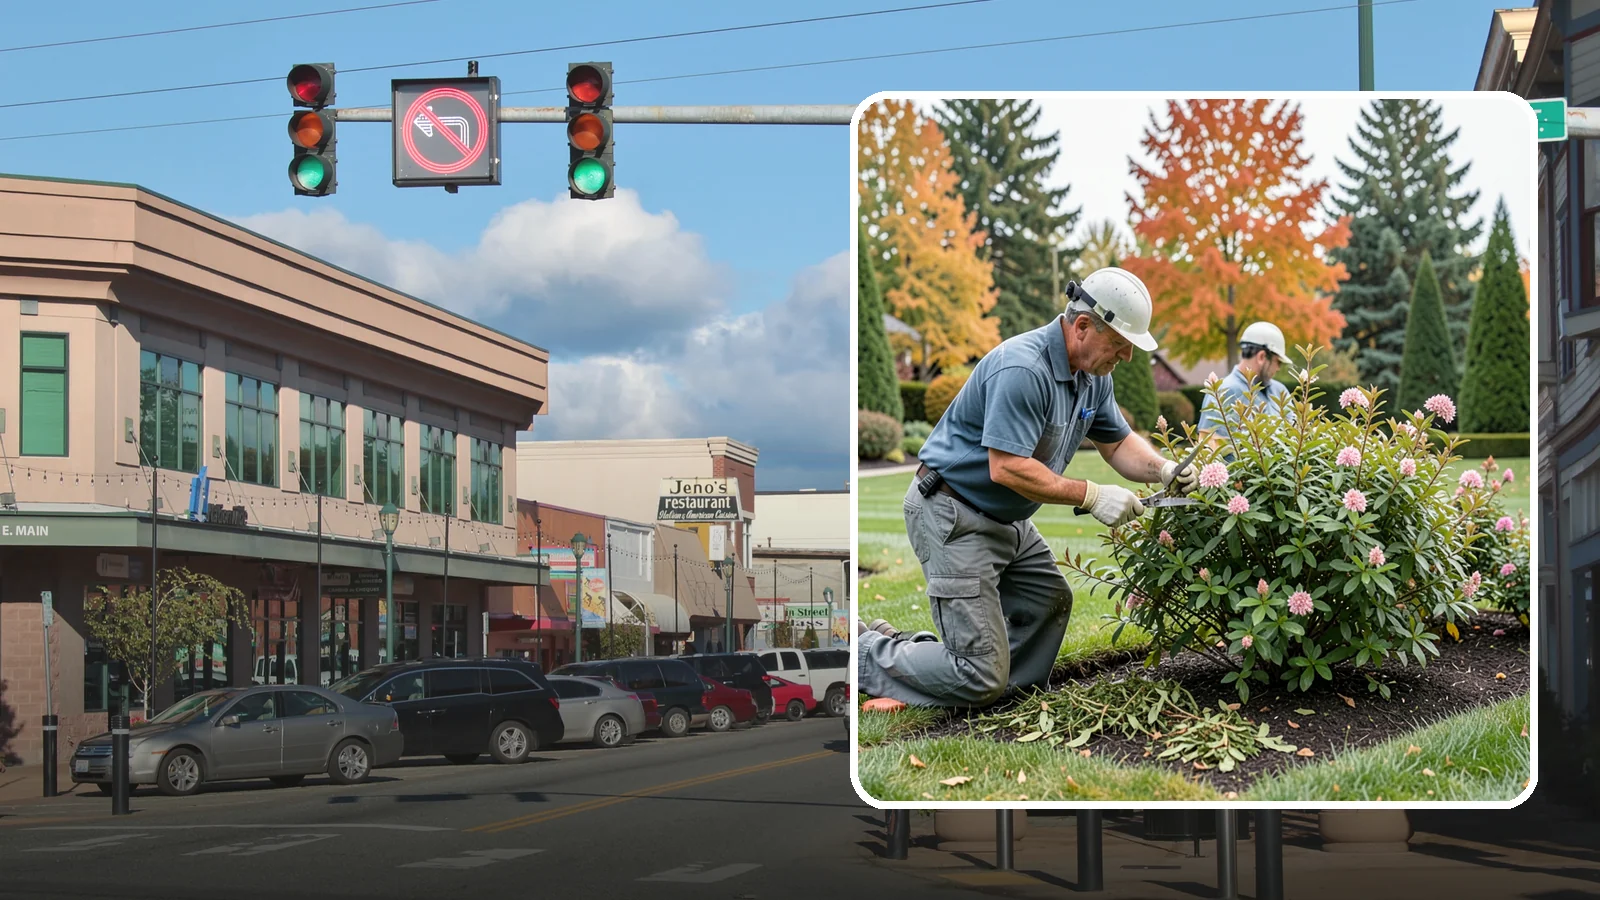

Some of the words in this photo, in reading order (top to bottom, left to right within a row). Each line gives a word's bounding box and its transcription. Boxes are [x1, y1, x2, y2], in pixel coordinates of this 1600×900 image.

[669, 479, 727, 494] Jeno's
[665, 496, 731, 509] restaurant
[659, 509, 681, 519] Italian
[686, 509, 714, 519] American
[715, 509, 737, 519] Cuisine
[2, 525, 13, 536] E.
[15, 525, 49, 536] MAIN
[797, 607, 828, 617] Street
[791, 619, 823, 627] lass
